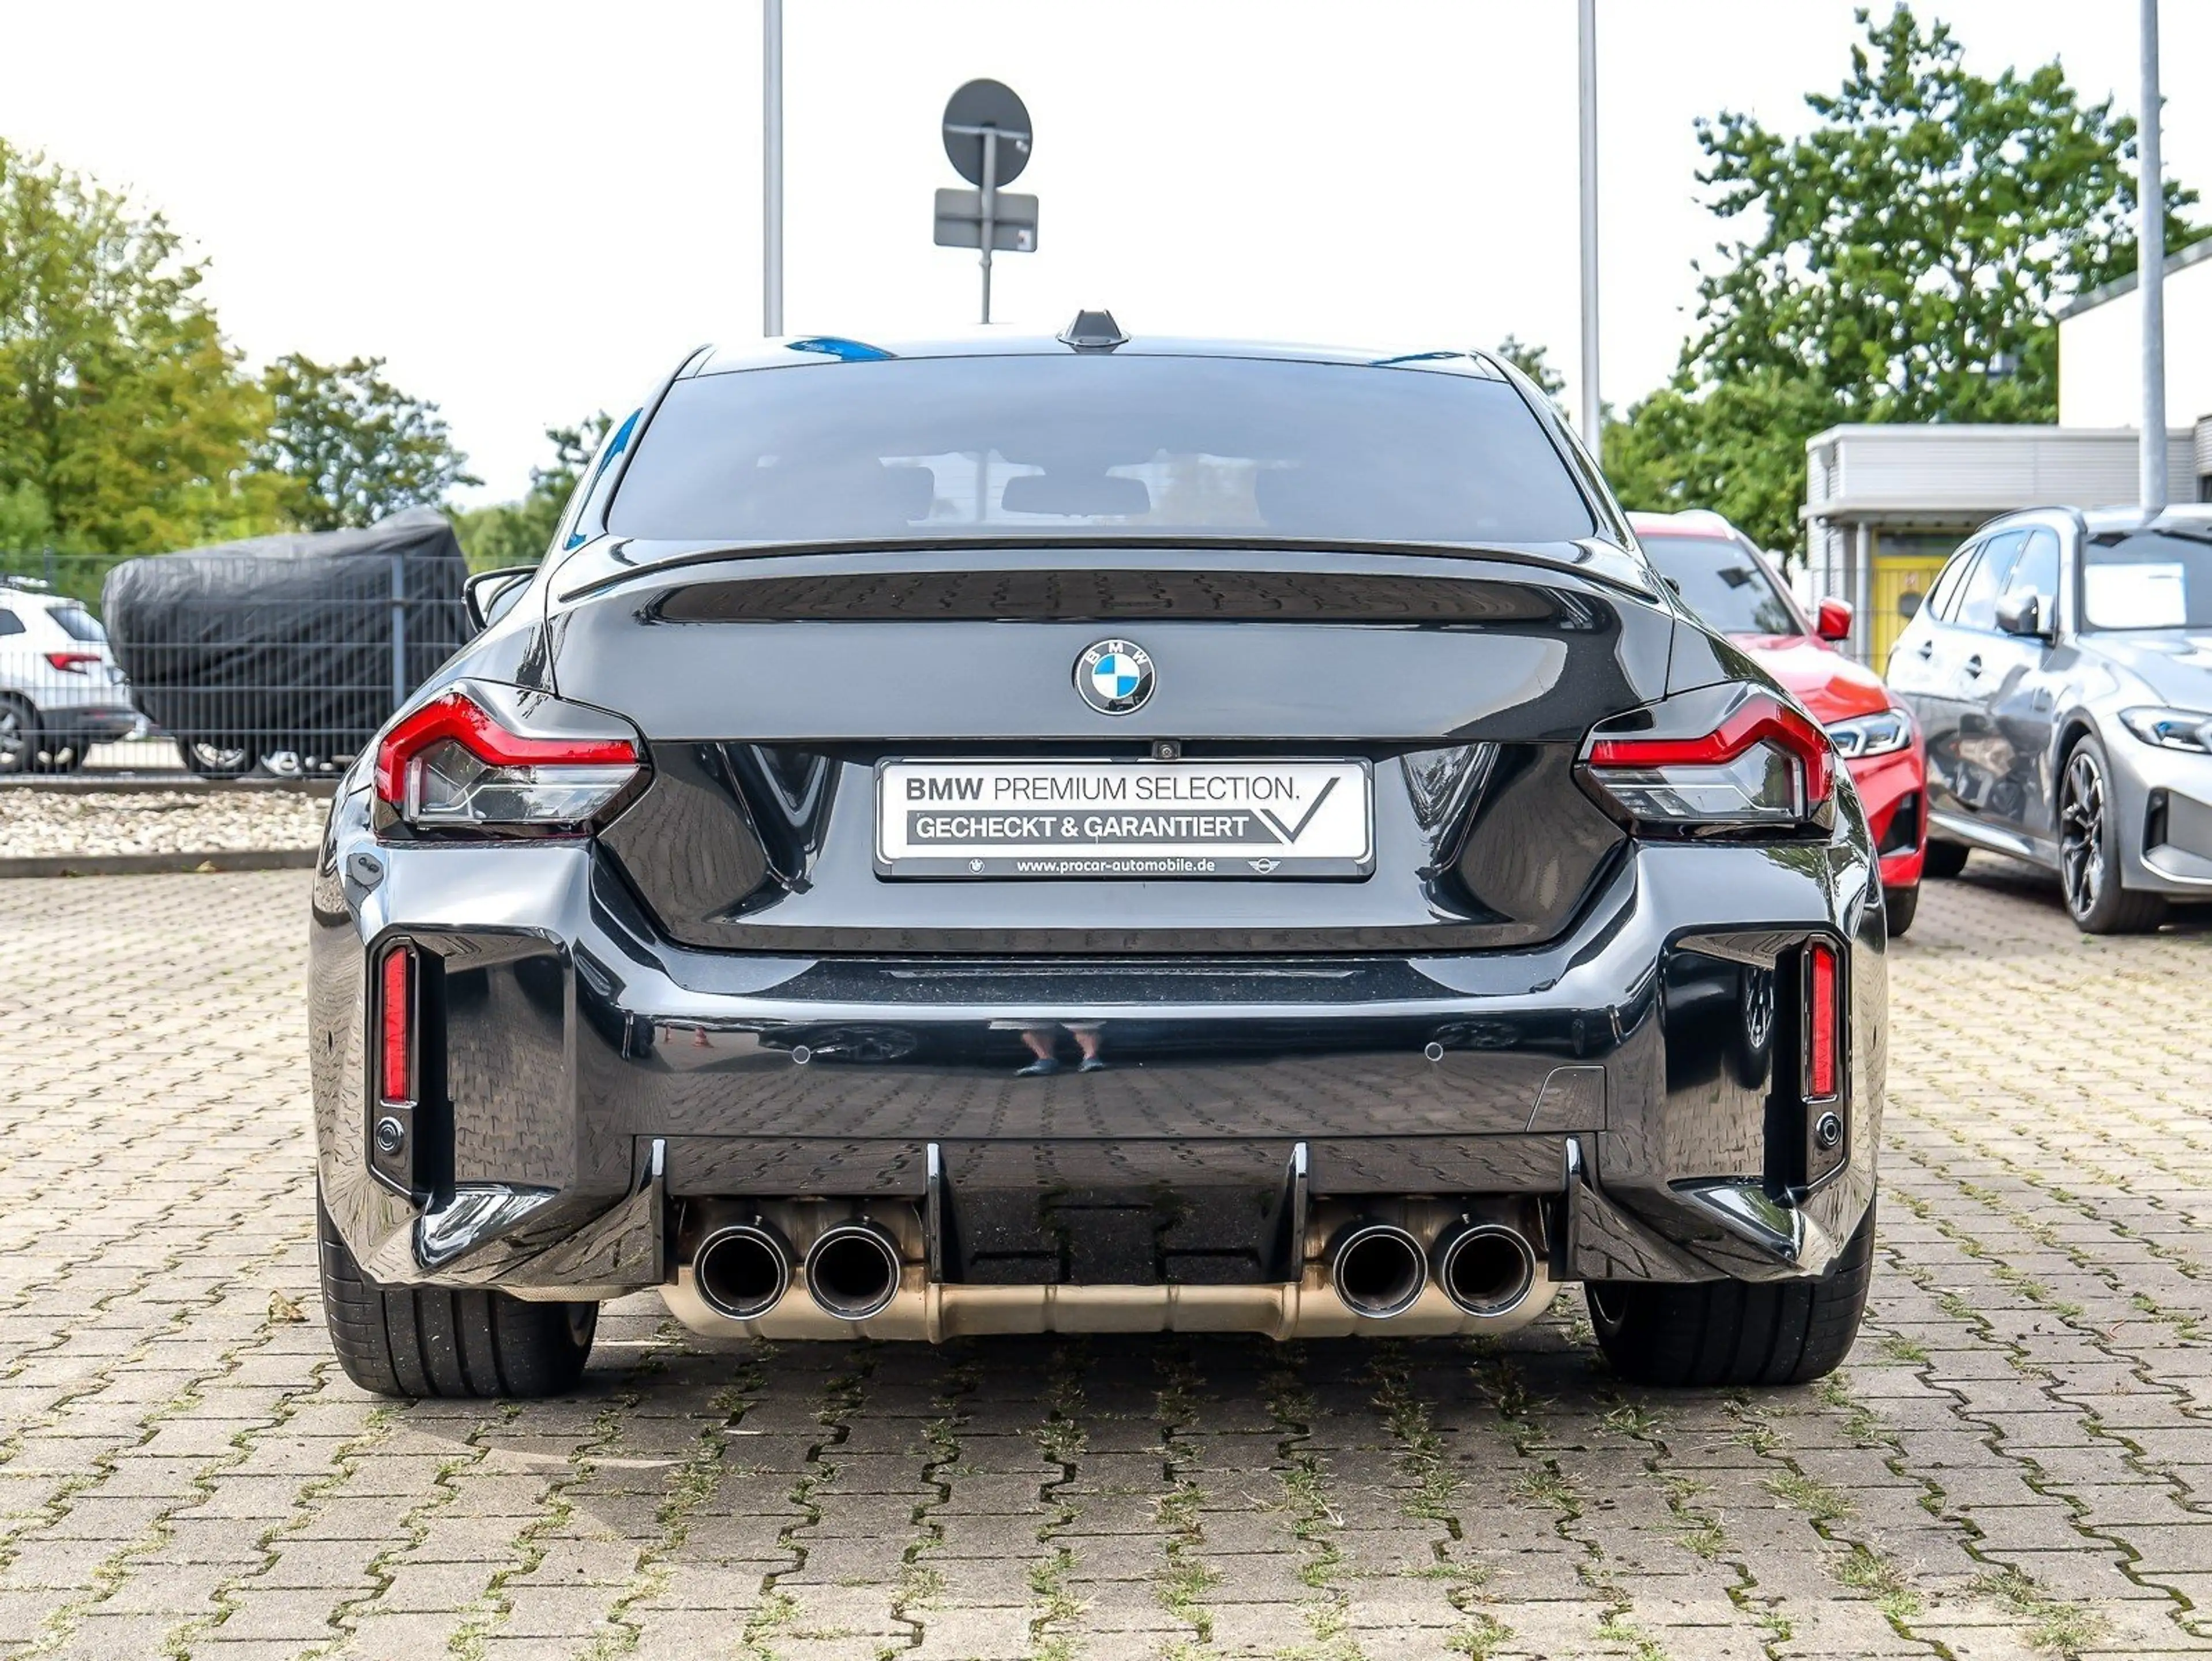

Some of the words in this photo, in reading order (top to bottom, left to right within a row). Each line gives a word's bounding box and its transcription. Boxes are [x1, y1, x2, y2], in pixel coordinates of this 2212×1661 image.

[1085, 642, 1148, 665] BMW
[907, 778, 983, 801] BMW
[994, 777, 1126, 800] PREMIUM
[1135, 776, 1300, 801] SELECTION.
[916, 817, 1057, 837] GECHECKT
[1060, 817, 1079, 838] &
[1084, 816, 1250, 837] GARANTIERT
[1017, 859, 1215, 873] www.procar-automobile.de
